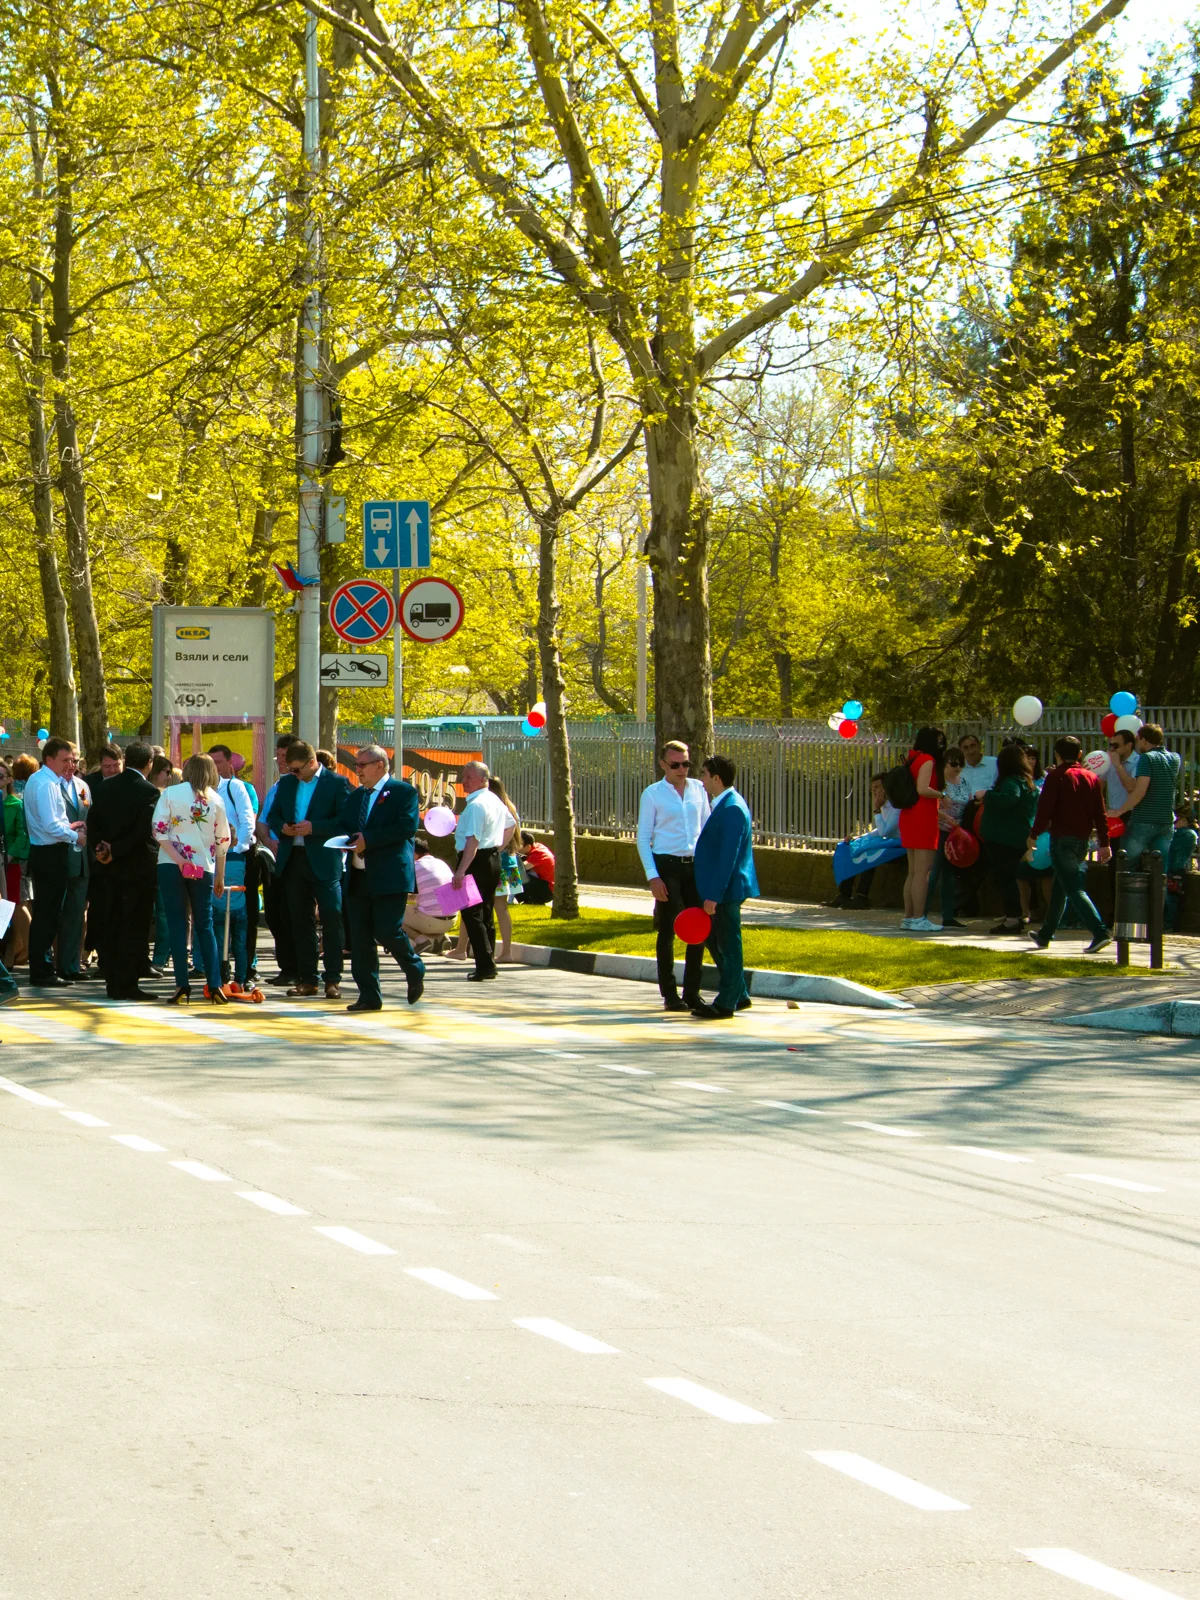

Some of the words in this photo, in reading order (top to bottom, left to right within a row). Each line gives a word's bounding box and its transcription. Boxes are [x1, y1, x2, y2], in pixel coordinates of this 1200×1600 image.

[175, 652, 209, 661] Взяли
[222, 654, 249, 662] сели
[174, 693, 218, 708] 499.-
